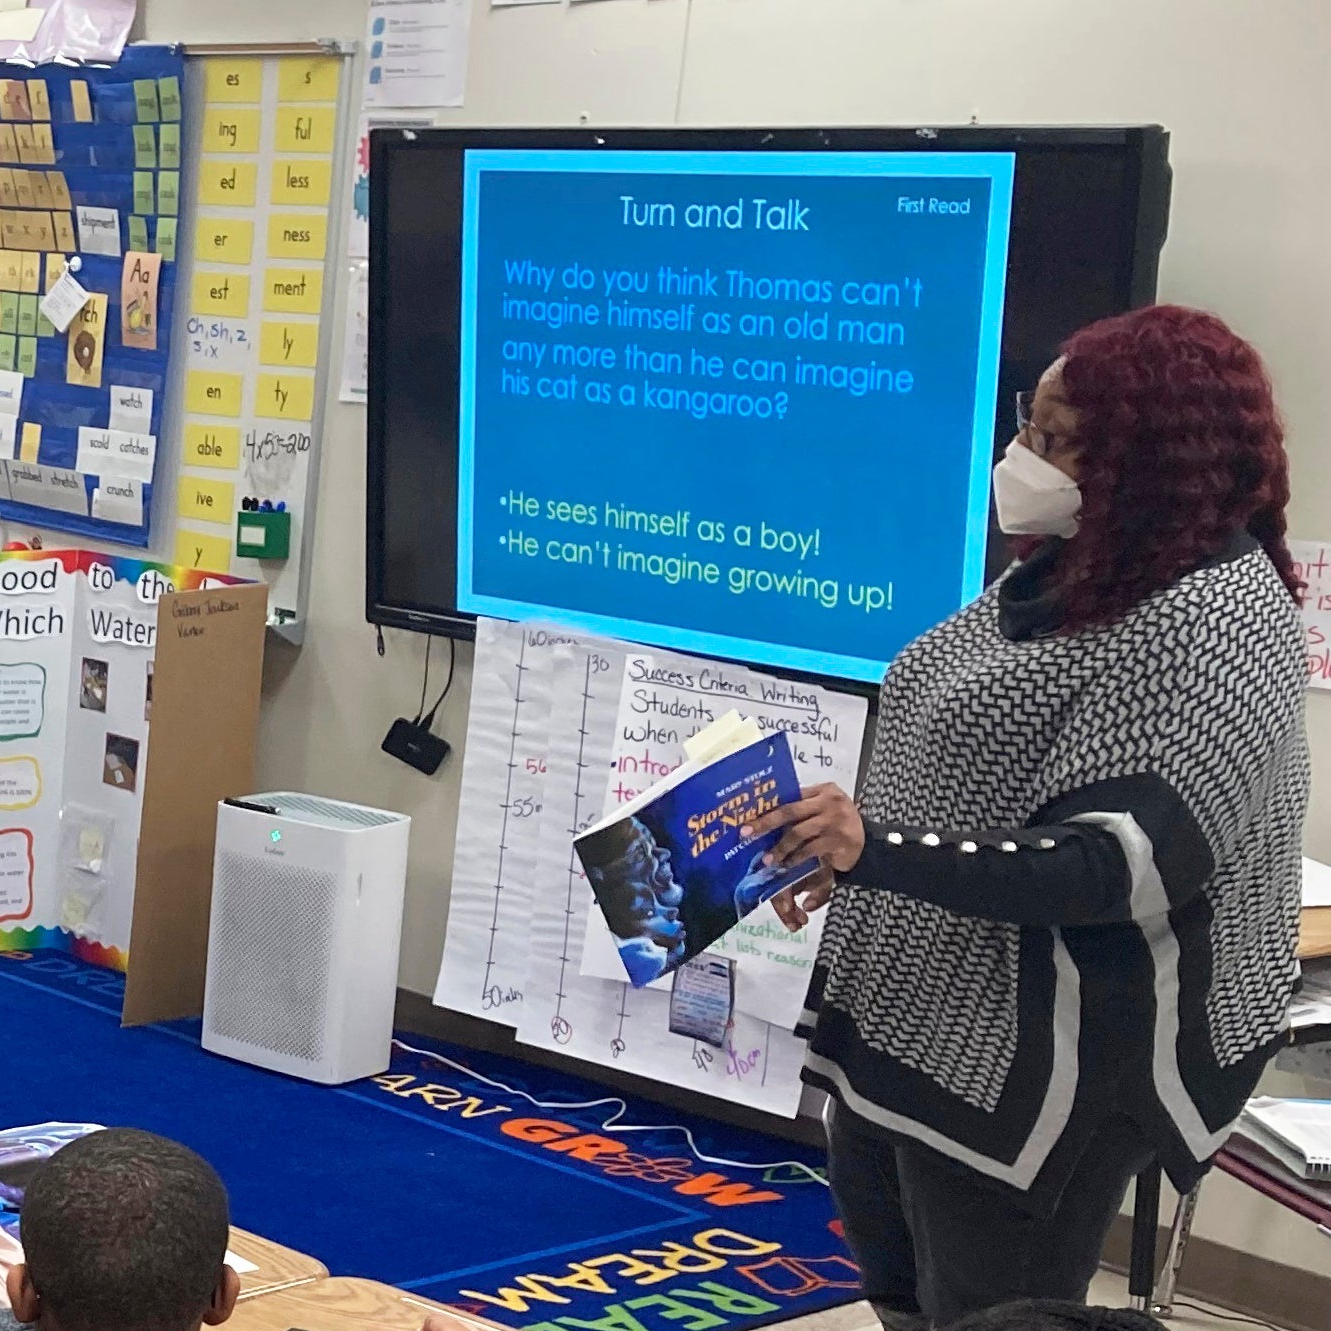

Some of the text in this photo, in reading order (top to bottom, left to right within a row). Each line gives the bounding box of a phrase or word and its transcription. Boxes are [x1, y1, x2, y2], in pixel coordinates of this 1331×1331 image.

[226, 73, 240, 86] es
[305, 71, 312, 85] s
[219, 121, 237, 146] ing
[295, 117, 312, 140] ful
[220, 167, 236, 190] ed
[286, 165, 310, 189] less
[620, 195, 810, 231] Turn and Talk
[897, 196, 971, 214] First Read
[80, 211, 116, 235] shipment
[283, 228, 310, 242] ness
[214, 234, 228, 246] er
[130, 257, 150, 285] Aa
[504, 258, 924, 307] Why do you think Thomas can't
[210, 278, 229, 300] est
[274, 274, 306, 297] ment
[503, 291, 905, 346] imagine himself as an old man
[283, 328, 293, 359] ly
[502, 339, 915, 397] any more than he can imagine
[206, 386, 221, 400] en
[274, 380, 289, 412] ty
[501, 367, 789, 420] his cat as a kangaroo?
[119, 437, 149, 456] catches
[197, 433, 223, 457] able
[11, 466, 79, 489] grabbed stretch
[106, 482, 135, 499] crunch
[196, 490, 214, 507] ive
[546, 498, 597, 526] sees
[604, 501, 691, 538] himself
[697, 518, 725, 544] as
[733, 524, 752, 547] a
[760, 521, 822, 561] boy!
[195, 546, 203, 568] y
[92, 563, 114, 591] to
[141, 569, 175, 601] the
[546, 538, 611, 569] can't
[617, 544, 720, 585] imagine
[728, 564, 839, 608] growing
[847, 581, 894, 614] up!
[90, 608, 156, 645] Water
[629, 659, 694, 688] Success
[760, 682, 820, 722] Writing
[630, 688, 839, 743] Students successful
[623, 720, 678, 745] when
[525, 758, 547, 775] 56
[687, 779, 777, 838] Storm in
[691, 829, 721, 859] the
[459, 1227, 783, 1312] DREAM
